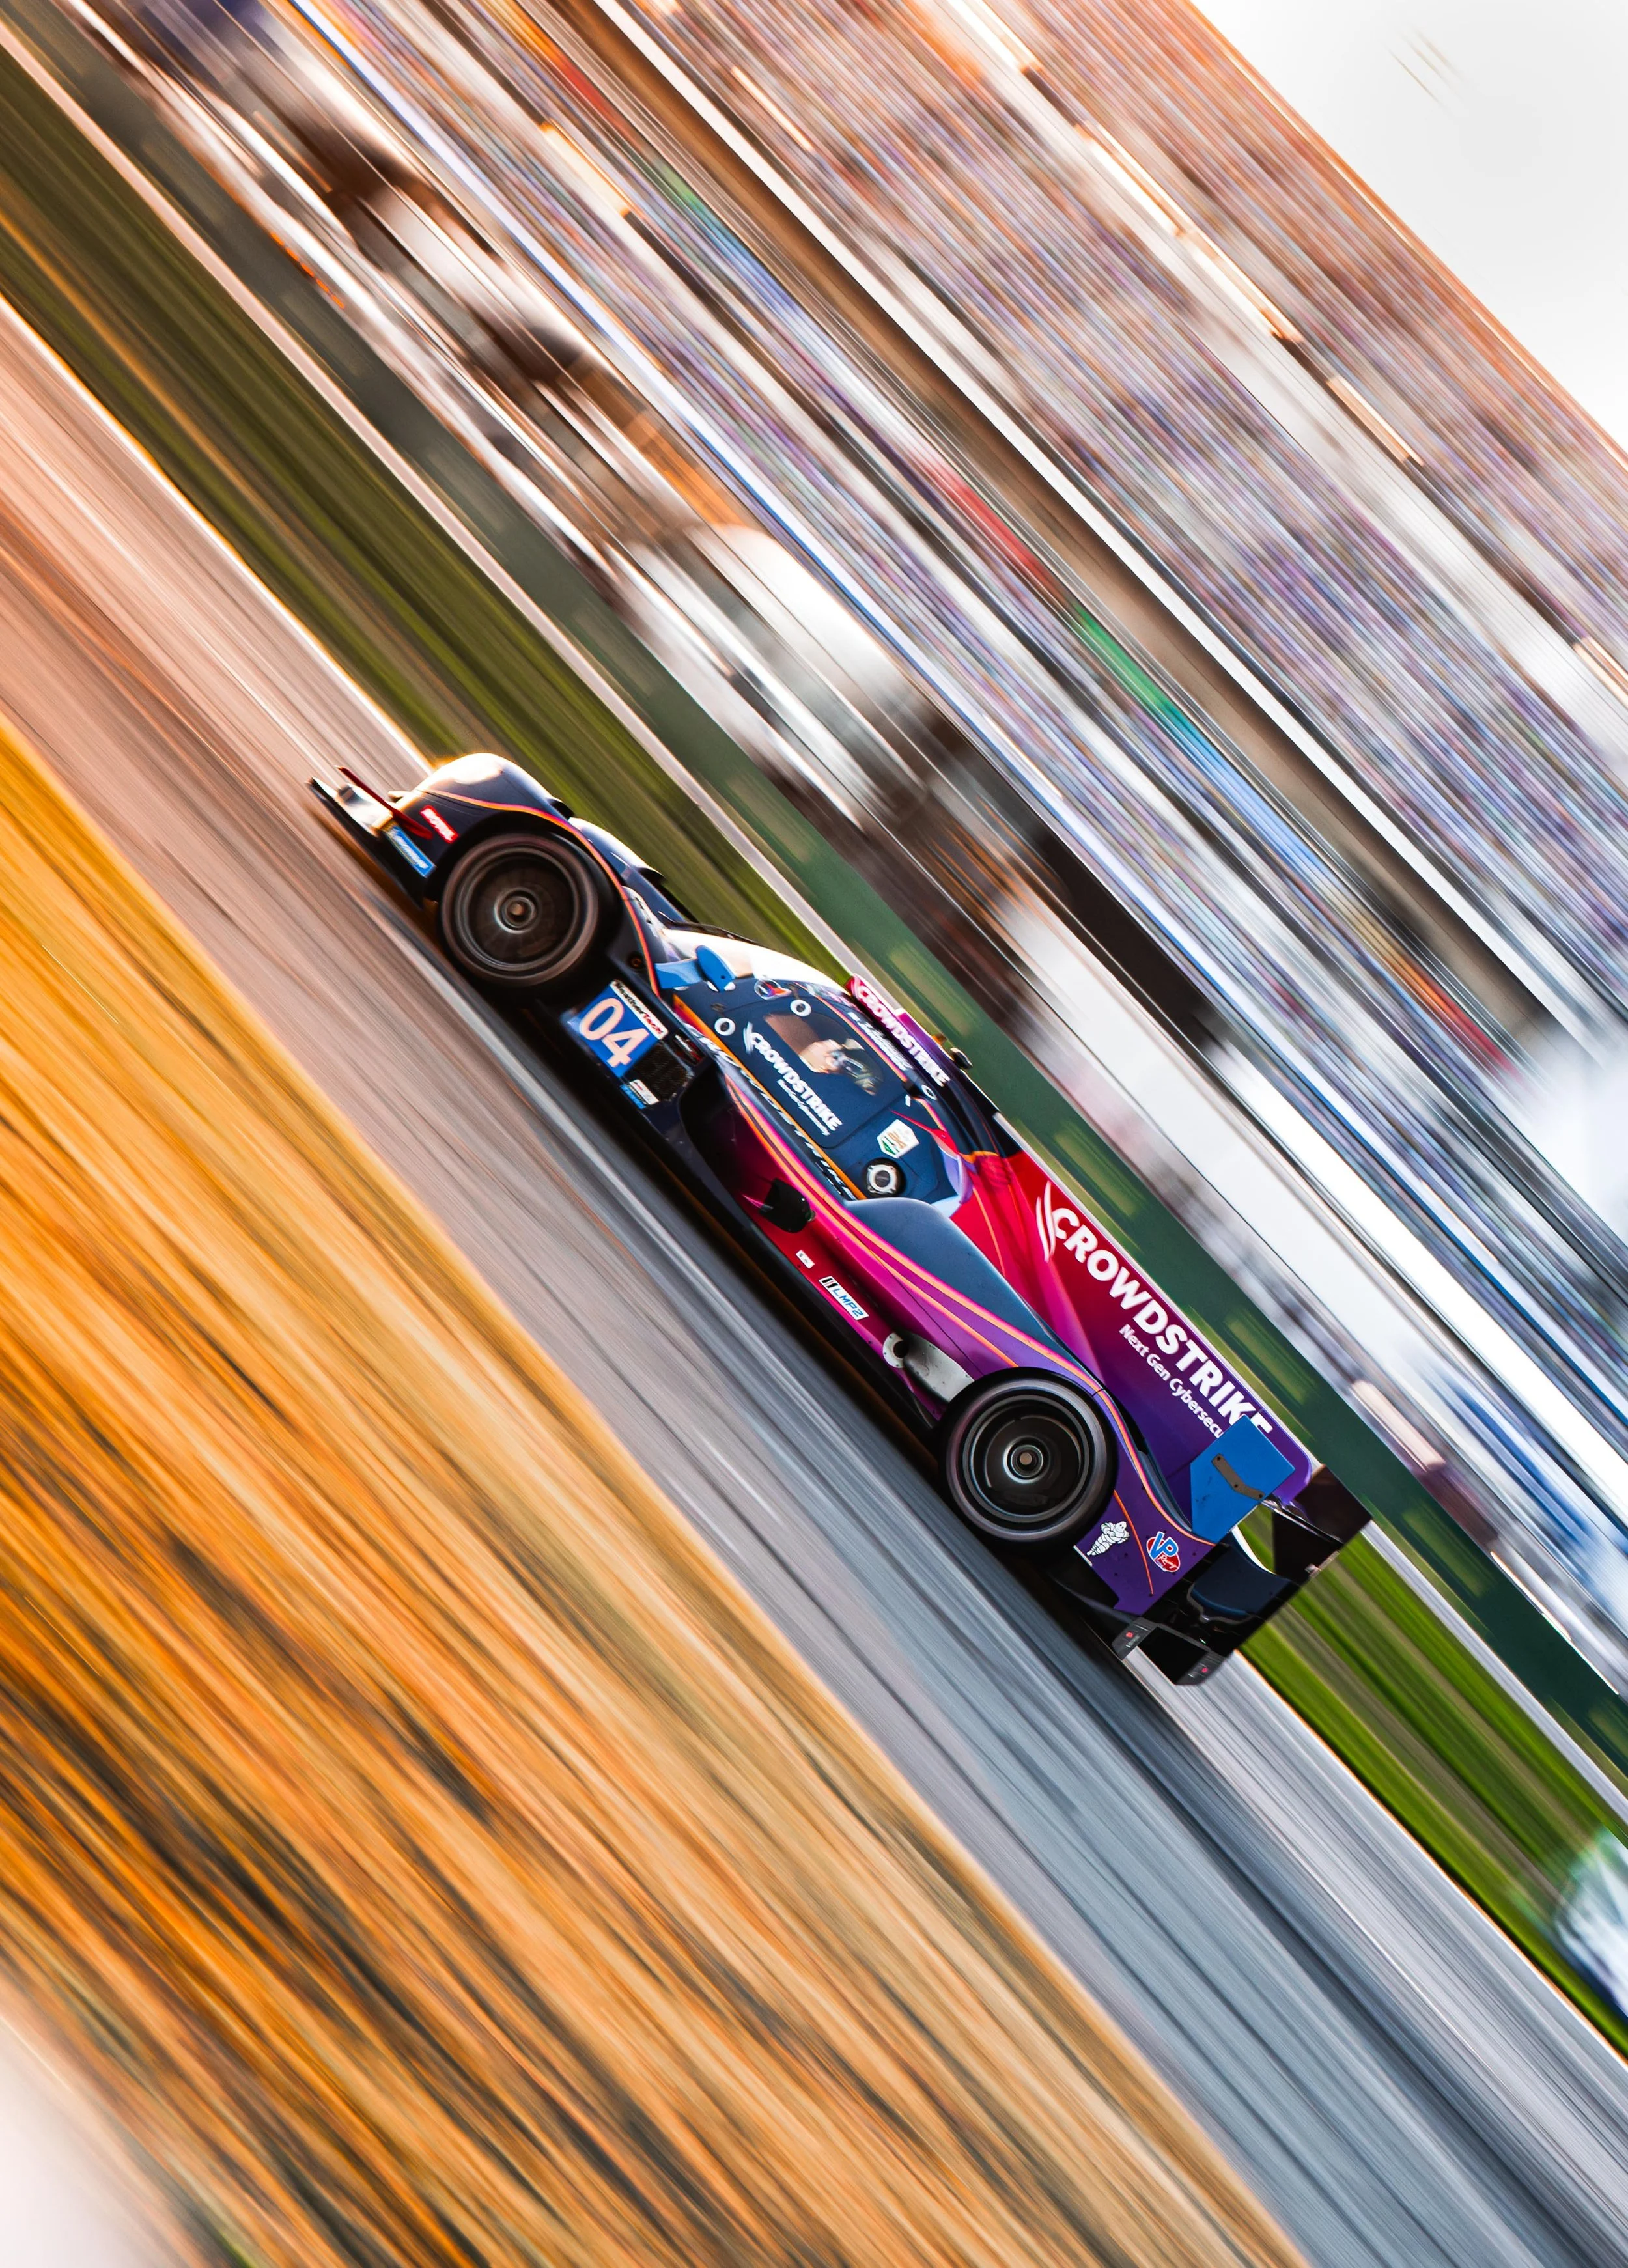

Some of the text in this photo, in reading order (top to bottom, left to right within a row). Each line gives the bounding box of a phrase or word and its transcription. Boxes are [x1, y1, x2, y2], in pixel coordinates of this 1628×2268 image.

[578, 998, 649, 1067] 04
[856, 985, 950, 1086] CROWDSTRIKE
[752, 1032, 842, 1130] CROWDSTRIKE
[833, 1289, 863, 1317] LMP2
[1119, 1324, 1149, 1357] Next
[1147, 1354, 1171, 1381] Gen
[1149, 1532, 1178, 1560] VP
